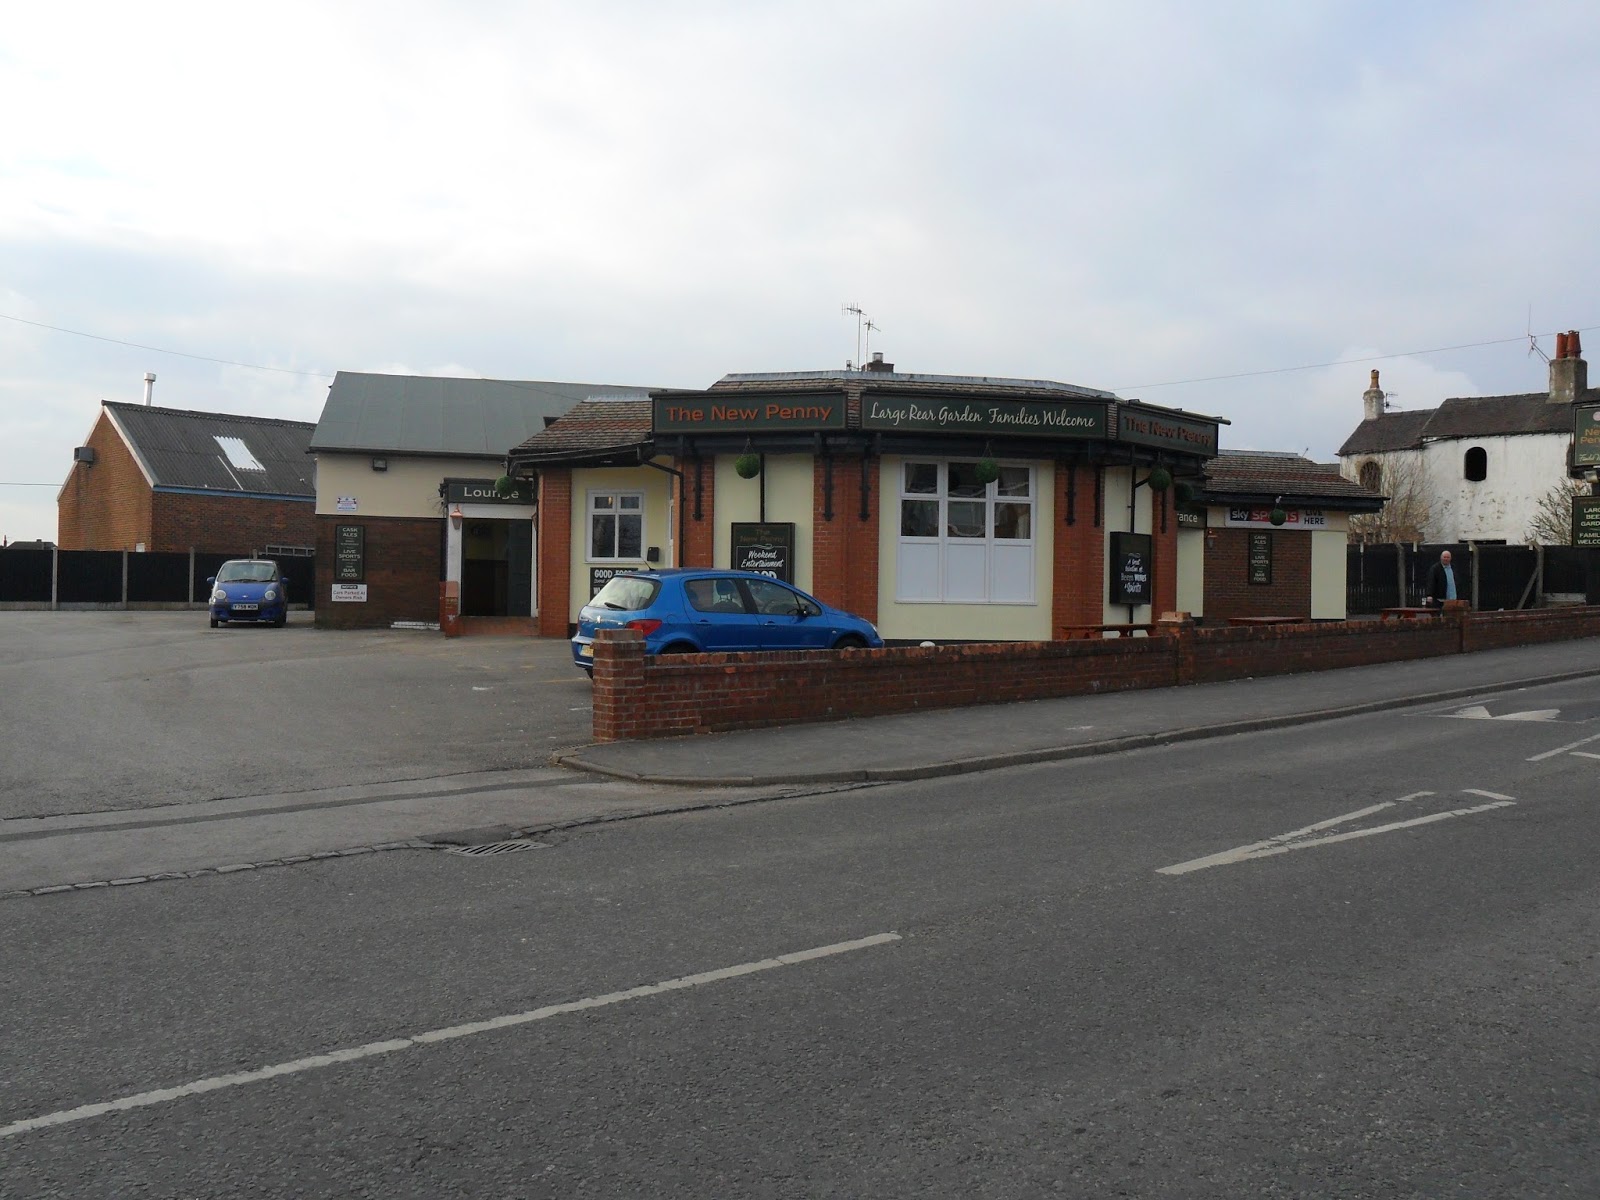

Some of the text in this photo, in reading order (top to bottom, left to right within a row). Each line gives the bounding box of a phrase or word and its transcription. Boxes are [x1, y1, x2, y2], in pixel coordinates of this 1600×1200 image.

[666, 404, 833, 422] The New Penny
[870, 401, 1096, 427] Large Rear Garden Families Welcome
[1125, 415, 1212, 447] The New Penny
[463, 486, 520, 500] Loune
[1231, 508, 1297, 522] sky SPTS
[1304, 517, 1325, 525] HERE
[748, 549, 778, 559] Weekend
[740, 558, 785, 568] Entertainment
[594, 569, 613, 579] GOOD
